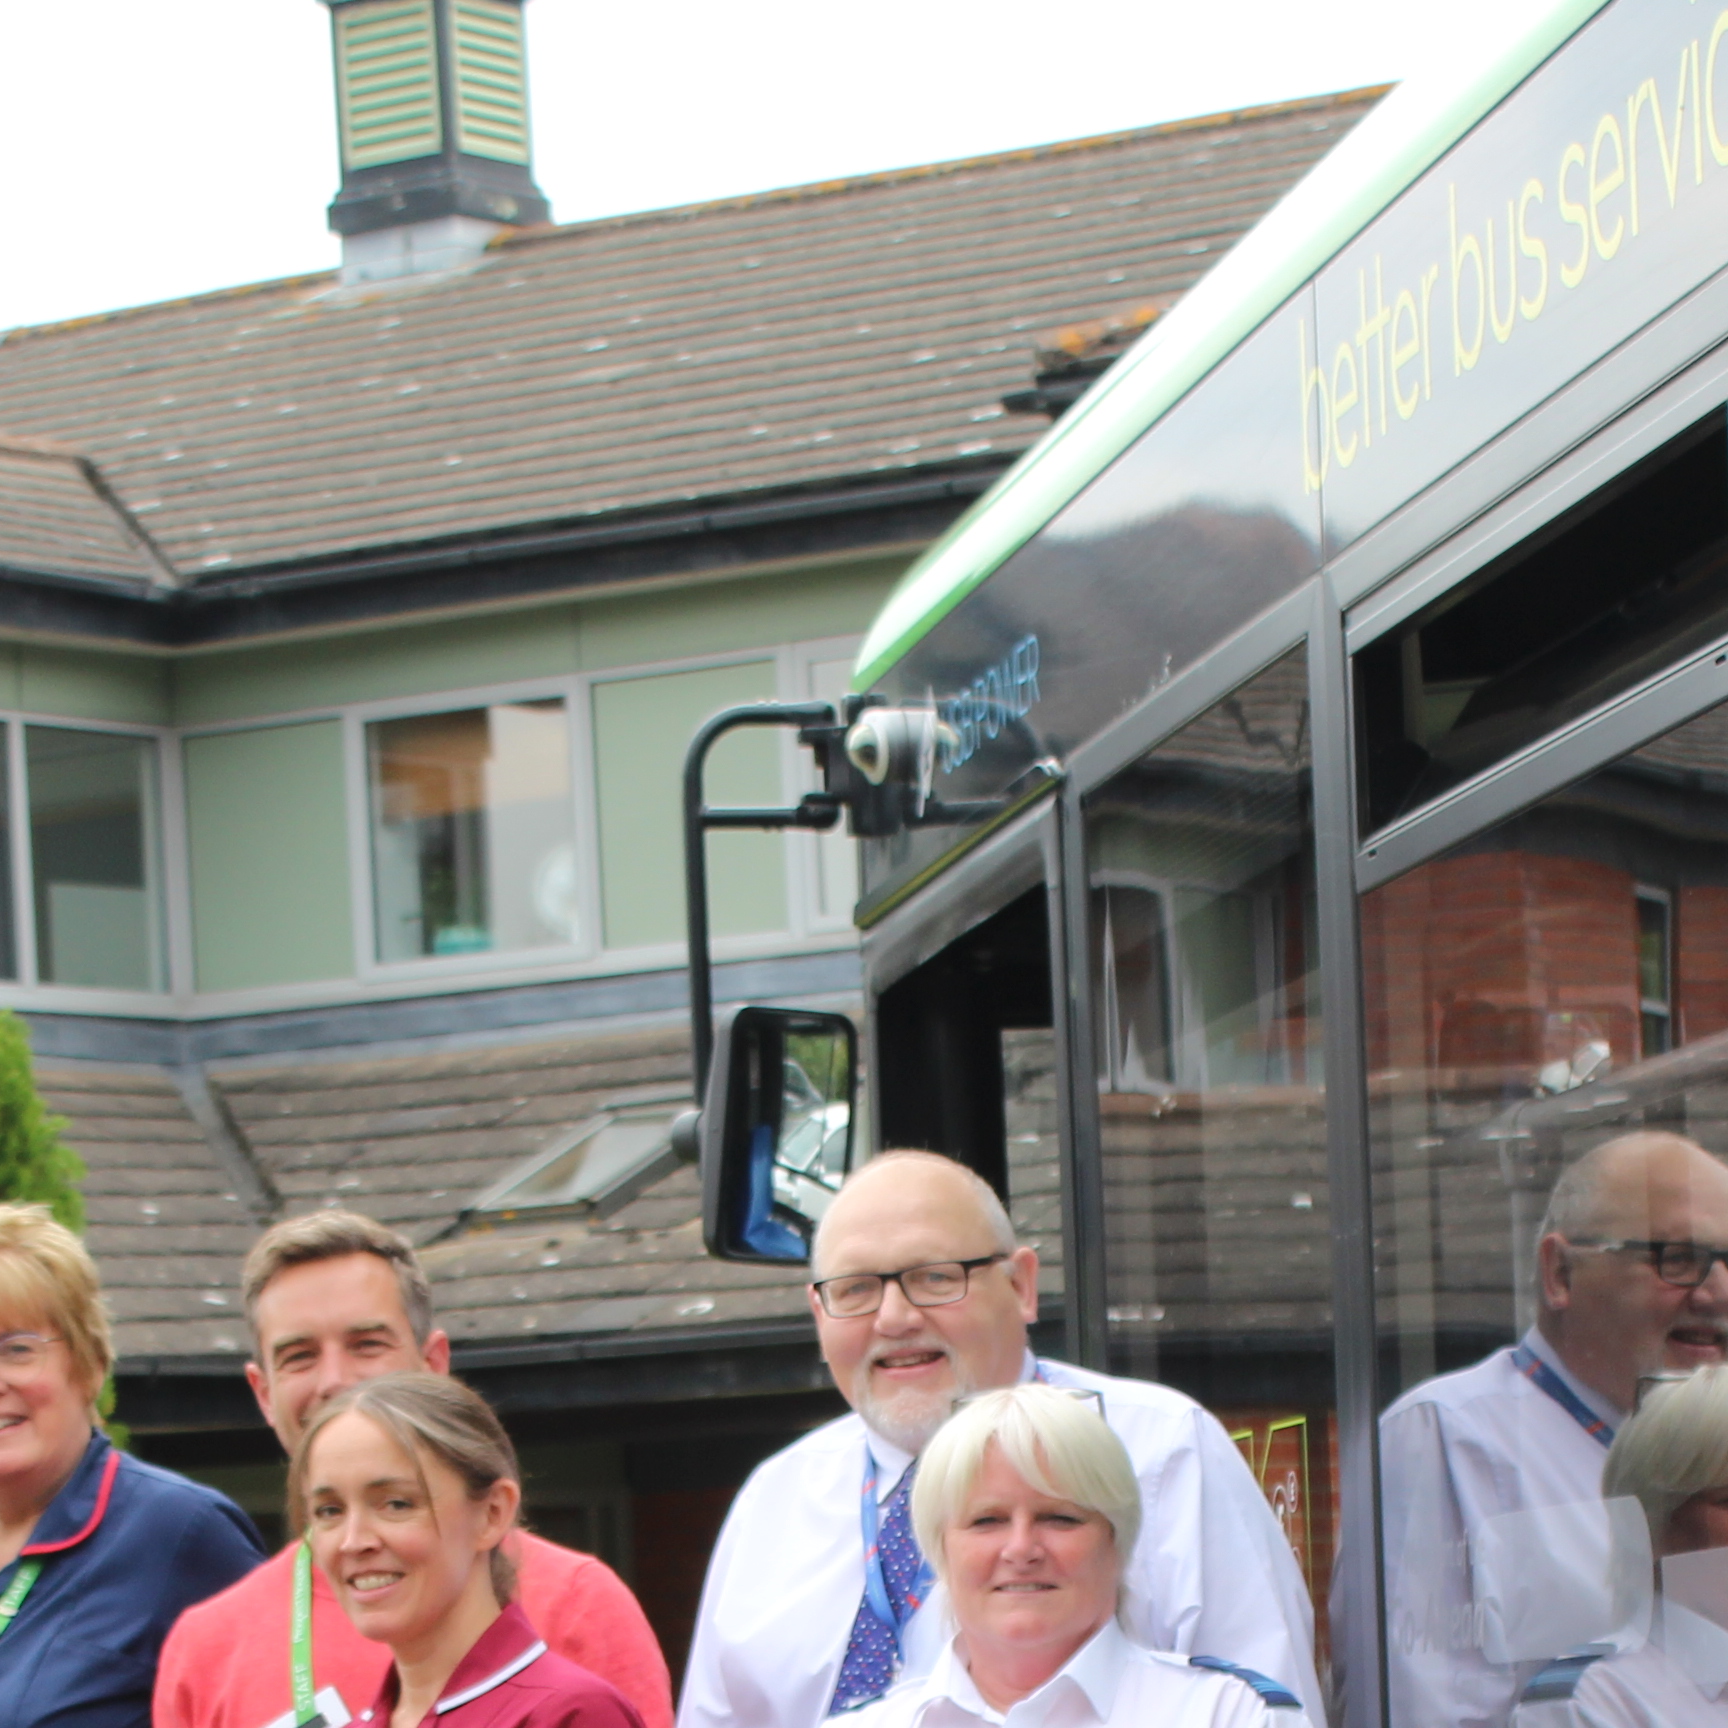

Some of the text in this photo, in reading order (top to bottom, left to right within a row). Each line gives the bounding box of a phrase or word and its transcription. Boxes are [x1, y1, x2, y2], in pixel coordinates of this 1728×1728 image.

[1297, 253, 1438, 496] better
[1448, 182, 1548, 378] bus
[297, 1664, 309, 1711] STAFF
